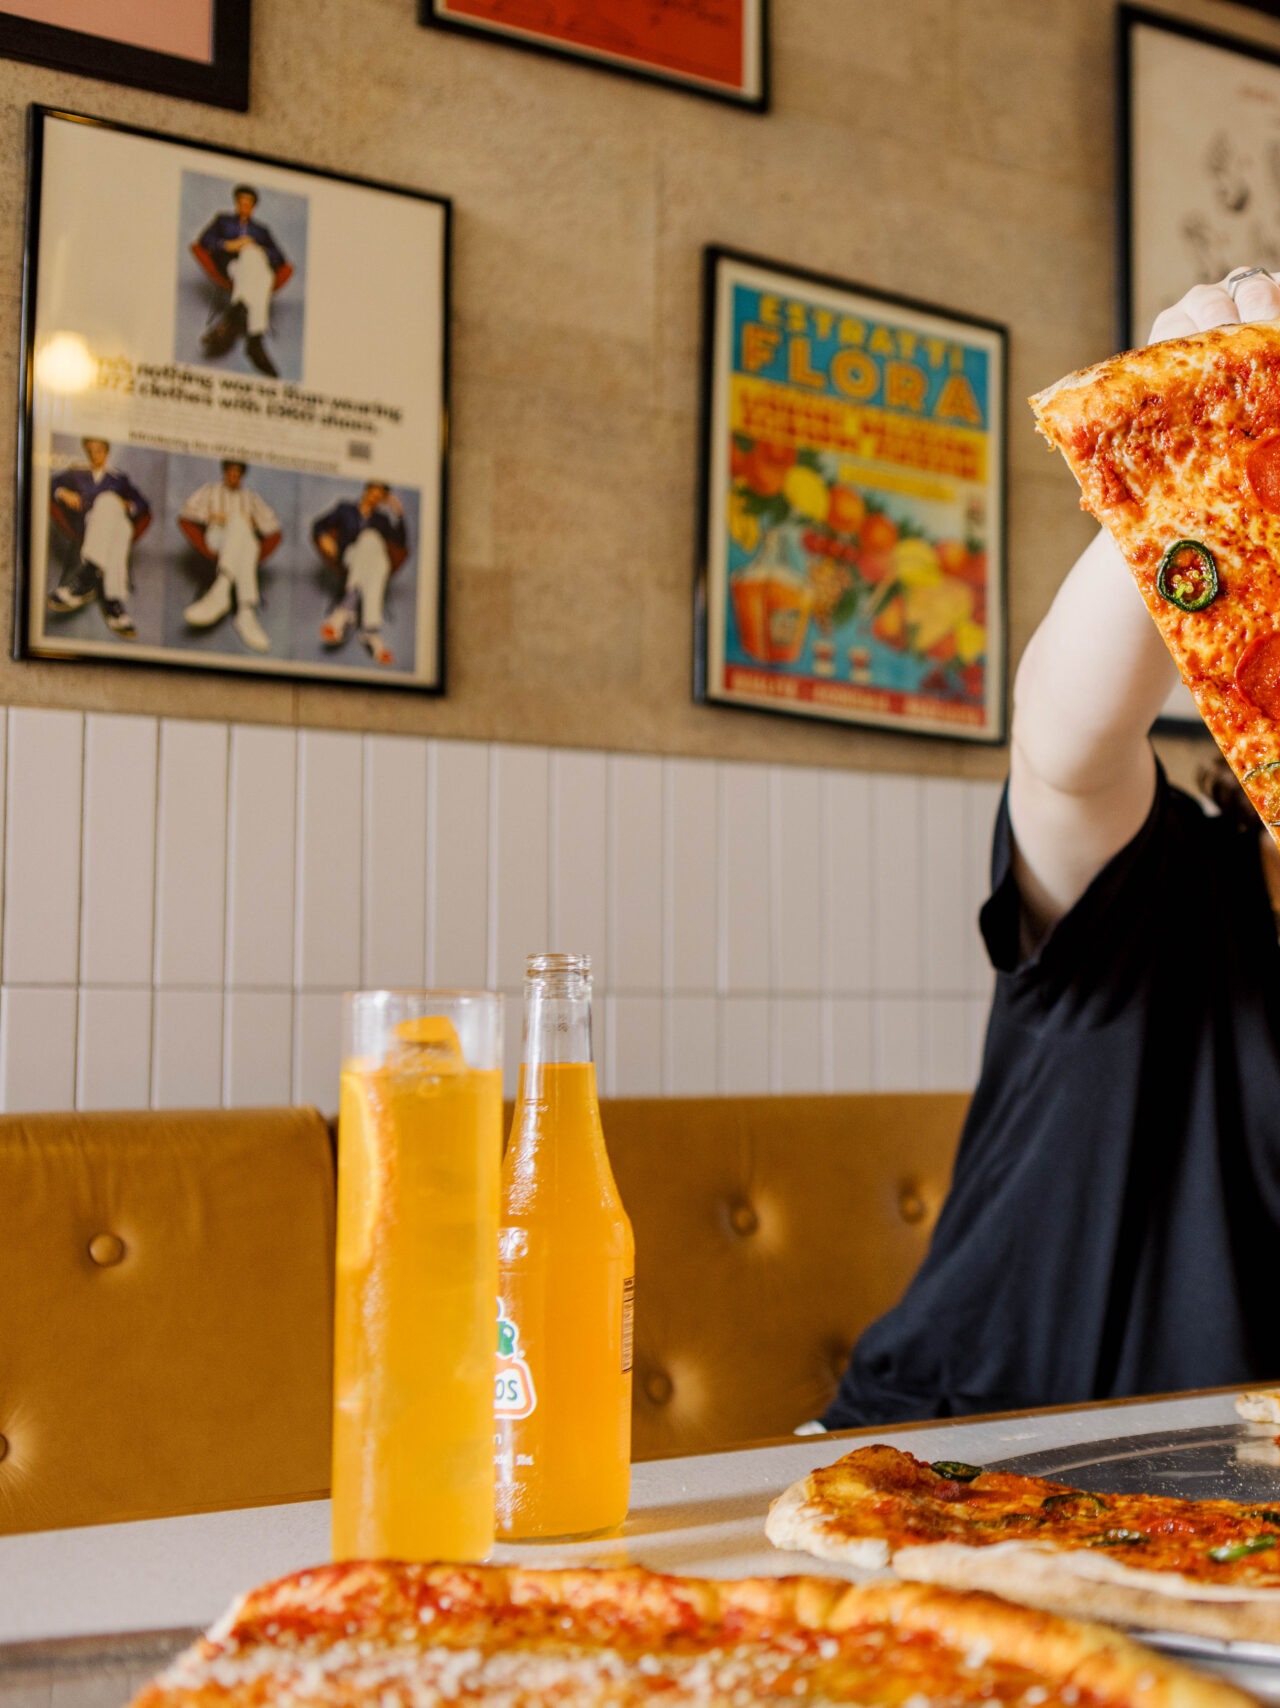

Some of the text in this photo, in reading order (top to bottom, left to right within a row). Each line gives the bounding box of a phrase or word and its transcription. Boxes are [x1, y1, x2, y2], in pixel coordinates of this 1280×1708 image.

[759, 293, 965, 372] ESTRATTI
[137, 360, 213, 389] nothing
[219, 376, 278, 398] worse
[138, 381, 213, 407] clothes
[218, 395, 262, 417] with
[742, 321, 983, 427] FLORA
